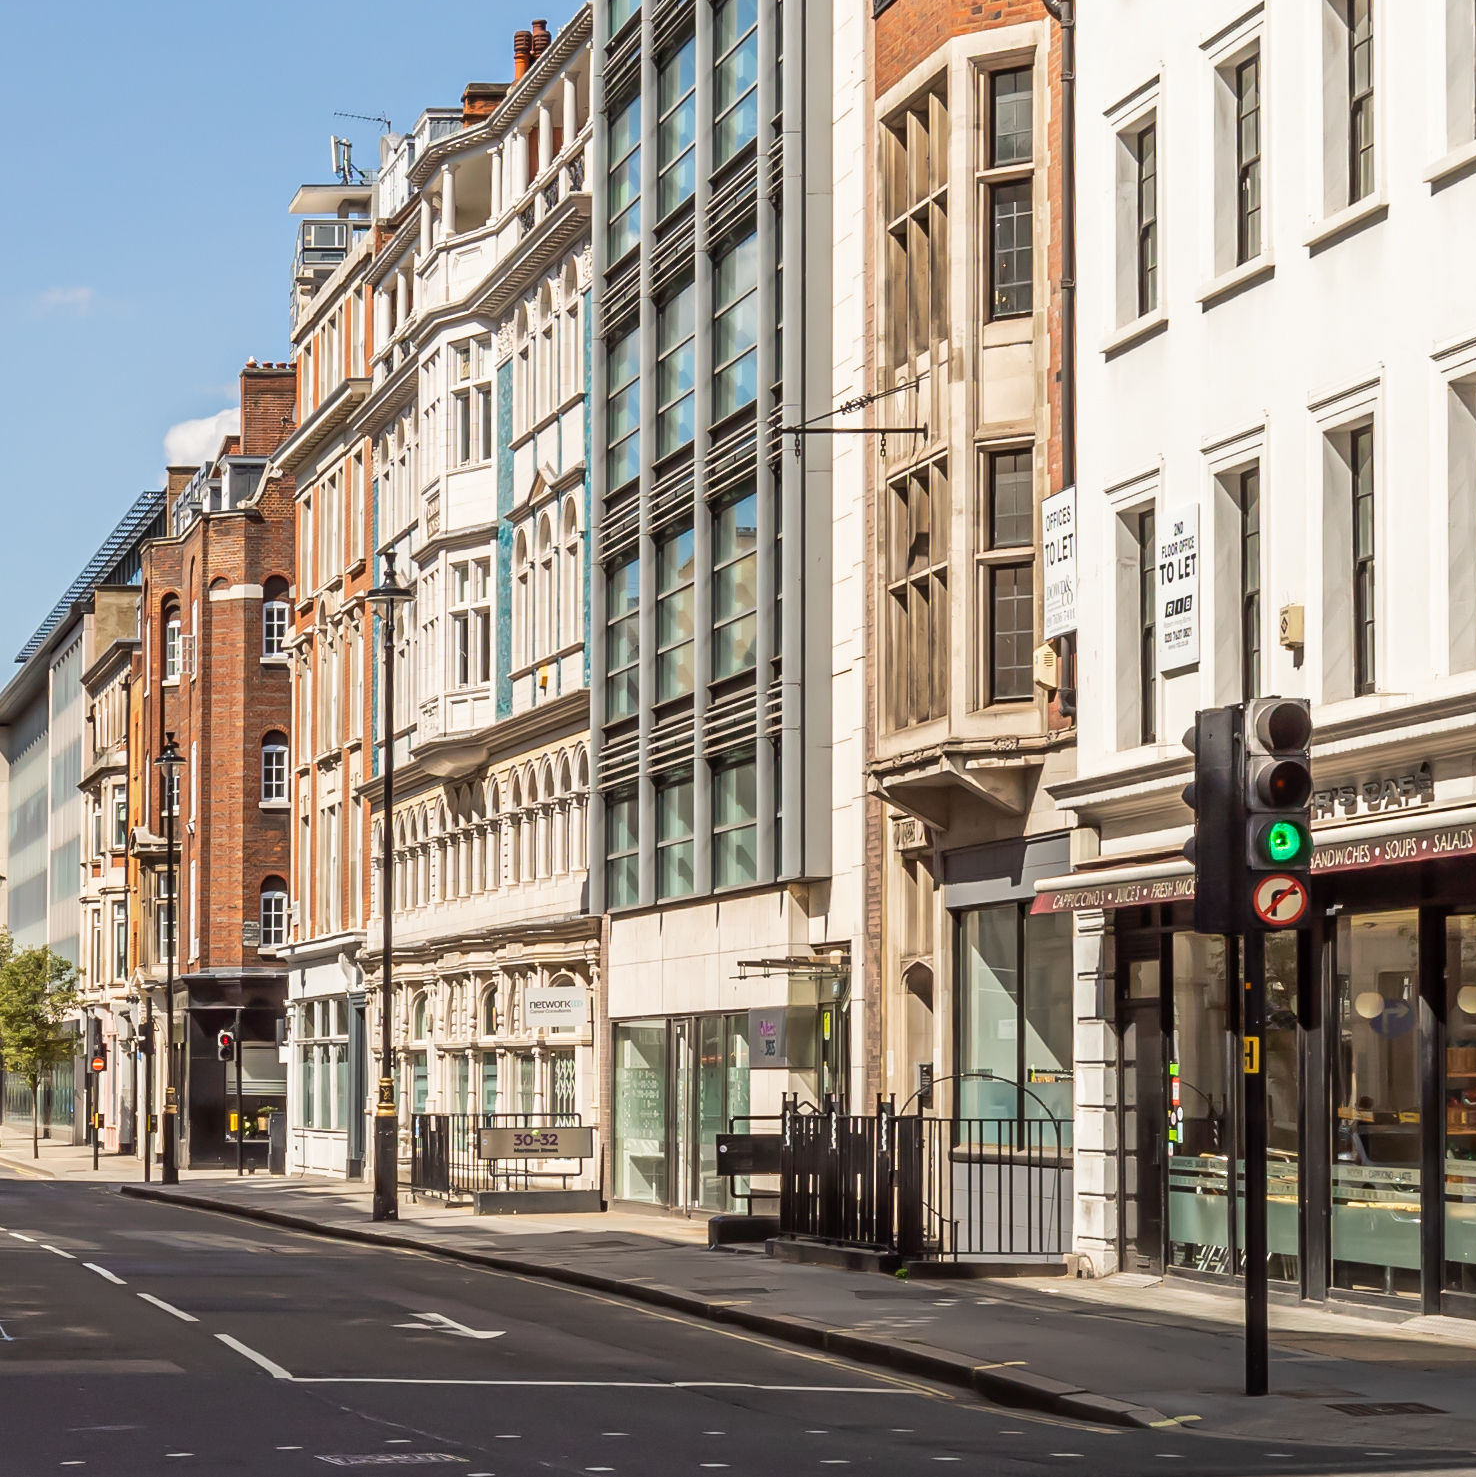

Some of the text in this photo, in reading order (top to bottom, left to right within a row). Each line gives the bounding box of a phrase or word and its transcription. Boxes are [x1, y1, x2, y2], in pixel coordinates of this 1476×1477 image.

[1046, 505, 1071, 532] OFFICES
[1045, 533, 1074, 568] TO LET
[1161, 542, 1178, 559] FLOOR
[1159, 553, 1197, 586] TO LET
[1385, 837, 1417, 860] SOUPS
[1432, 828, 1474, 853] SALADS
[1115, 885, 1140, 903] JUICES
[1150, 881, 1173, 899] FRESH
[529, 999, 572, 1009] network
[513, 1133, 559, 1146] 30-32
